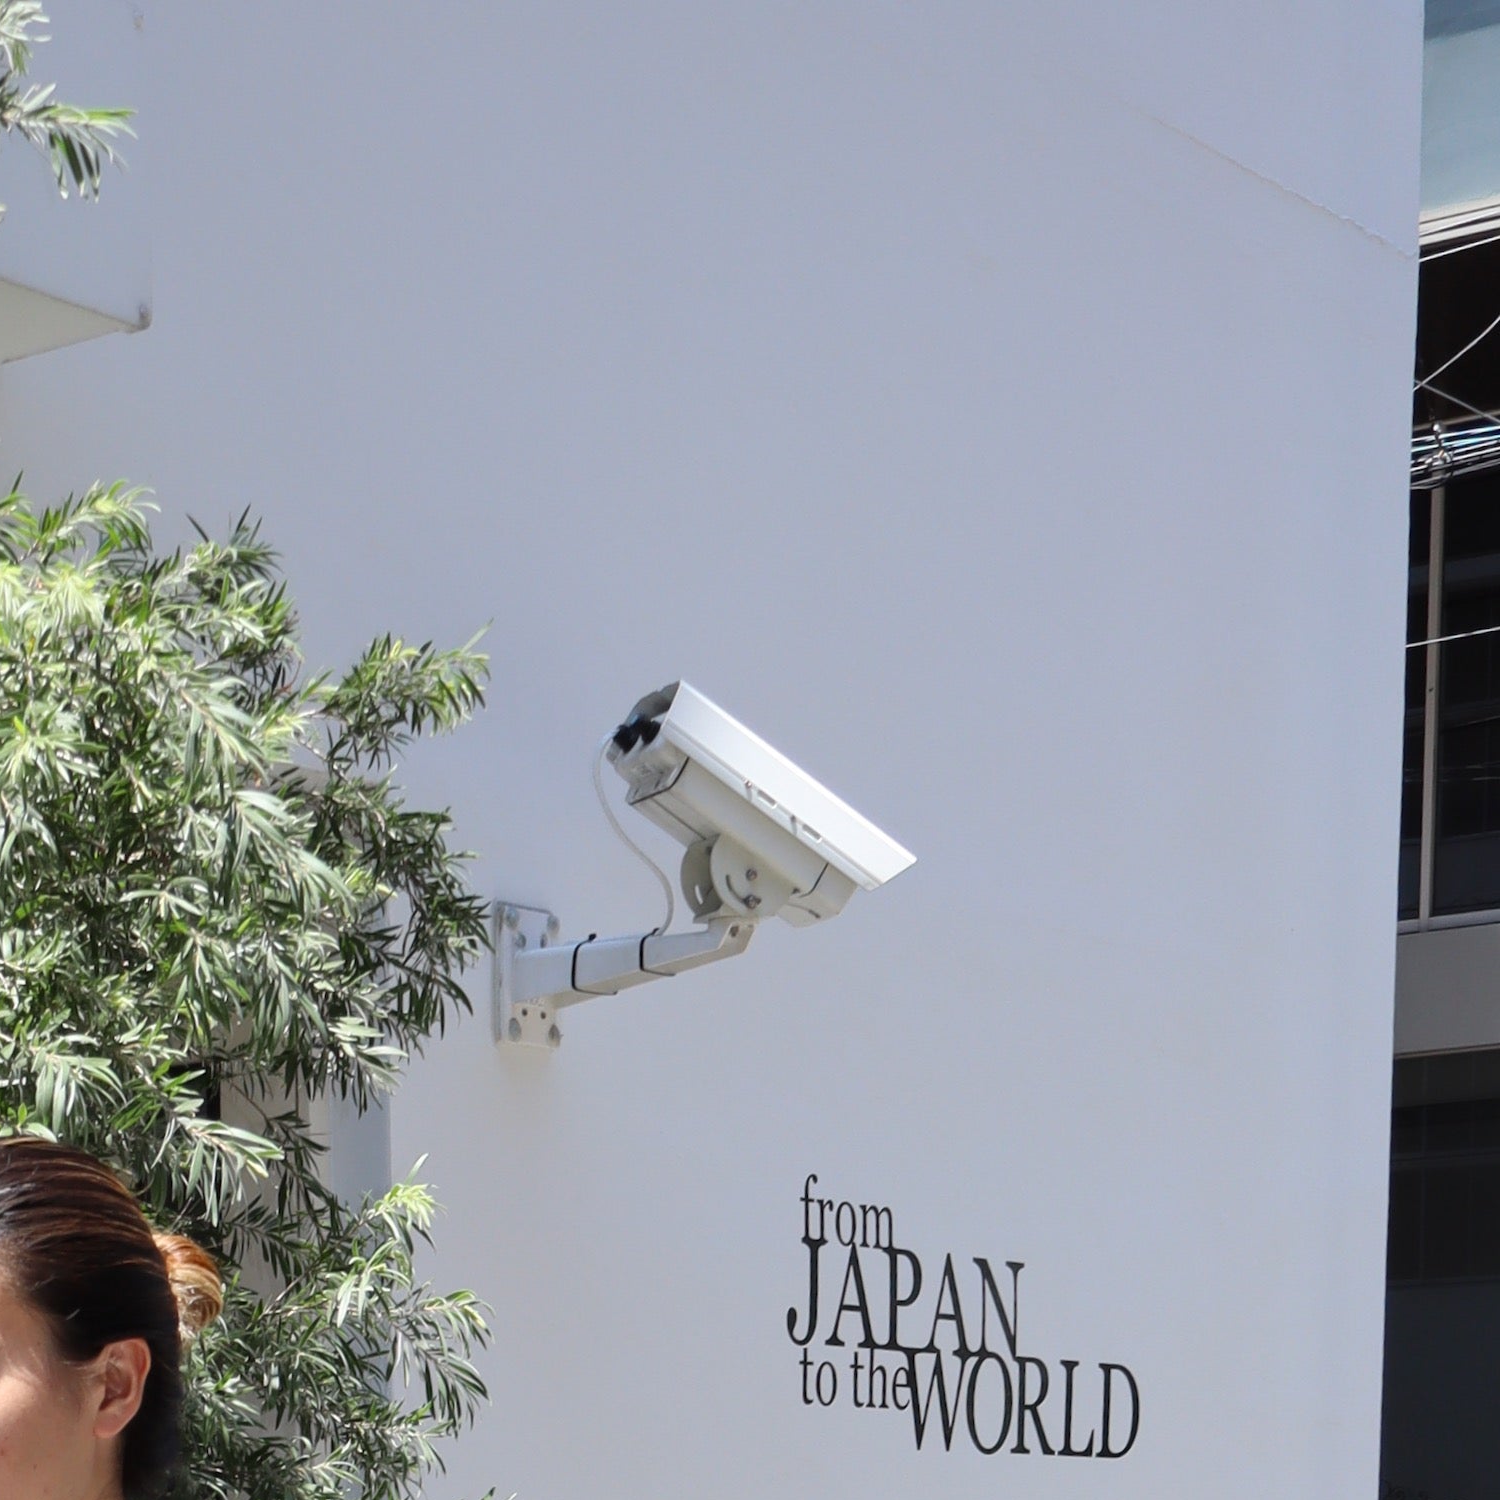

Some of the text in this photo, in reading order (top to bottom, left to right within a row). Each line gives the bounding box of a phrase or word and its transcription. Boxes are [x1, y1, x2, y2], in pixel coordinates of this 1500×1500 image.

[800, 1174, 896, 1248] from
[787, 1240, 1025, 1360] JAPAN
[799, 1347, 1140, 1459] to the WORLD
